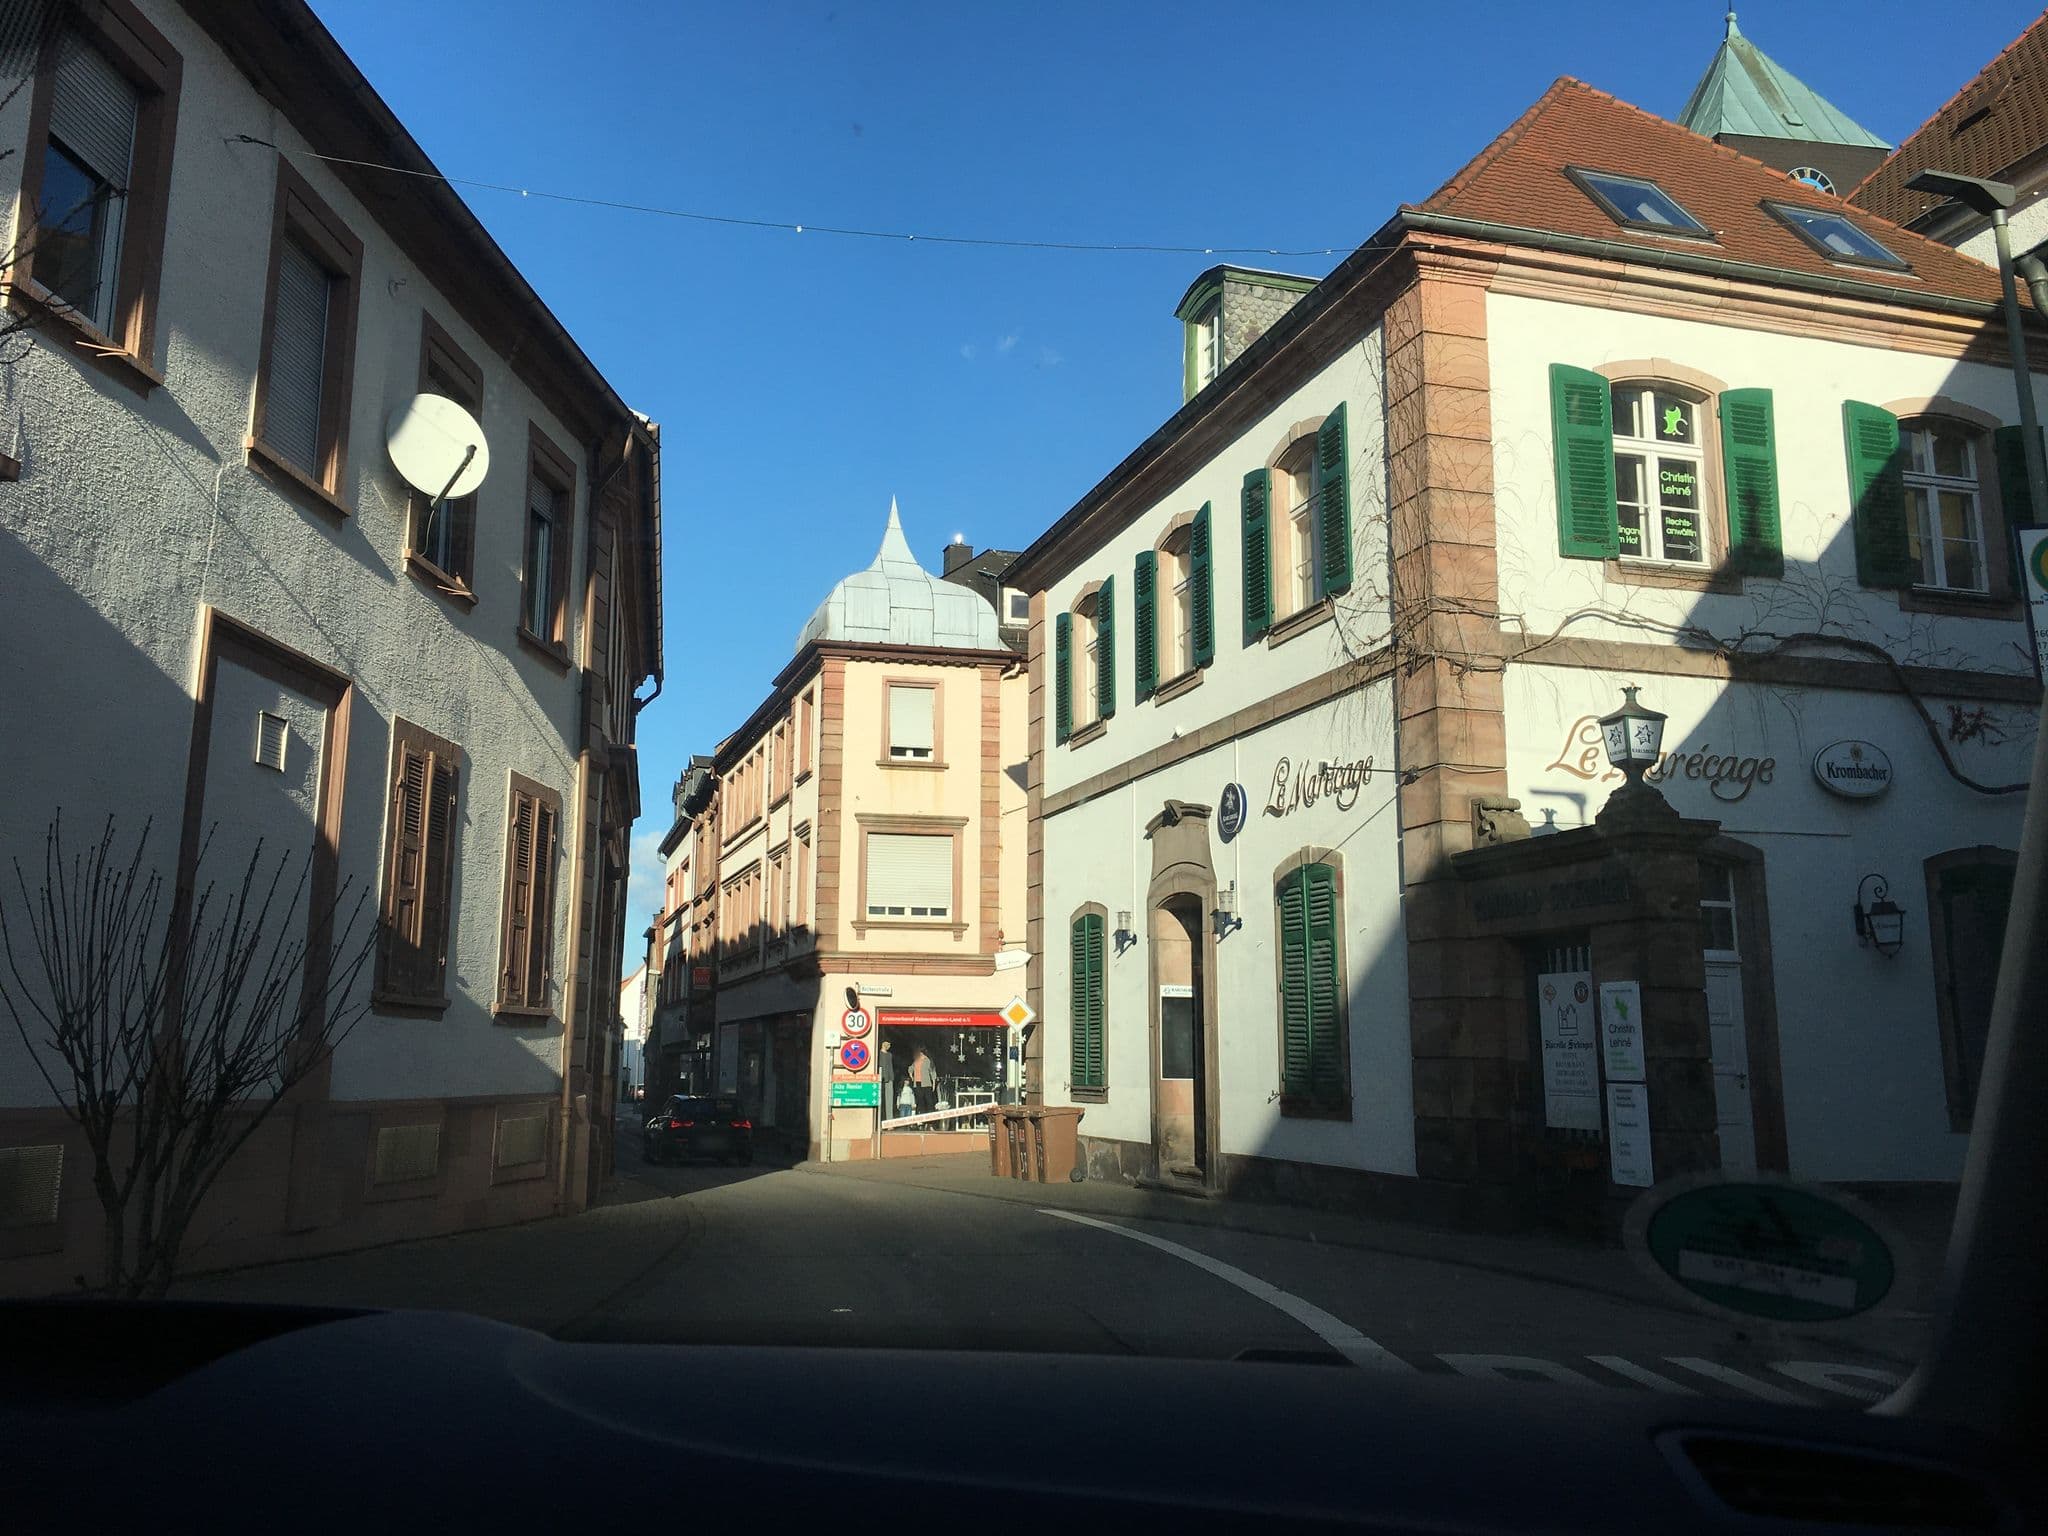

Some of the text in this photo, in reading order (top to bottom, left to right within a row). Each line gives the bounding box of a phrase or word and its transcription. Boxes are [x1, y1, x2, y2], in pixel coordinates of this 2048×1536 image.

[1660, 471, 1696, 484] Christin
[1661, 484, 1691, 496] Lehné
[1545, 714, 1776, 803] Le arécage
[1826, 760, 1888, 781] Krombacher
[847, 1014, 865, 1028] 30
